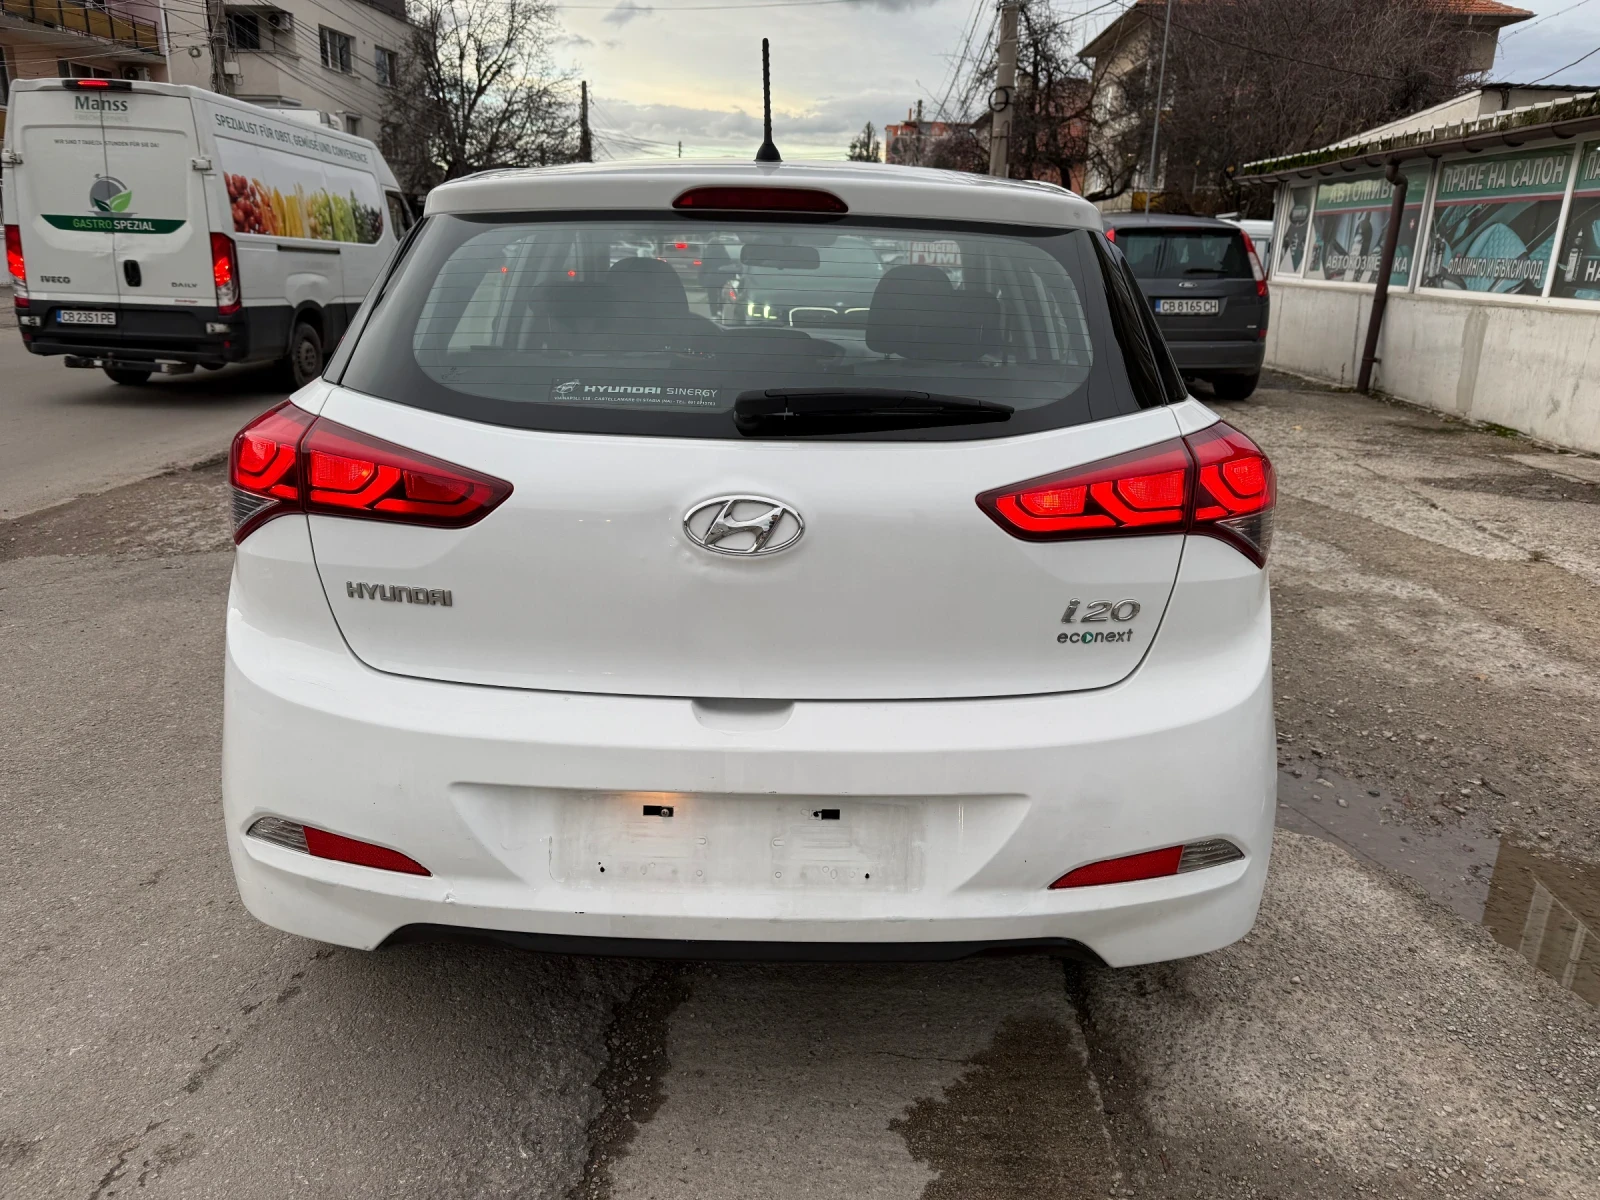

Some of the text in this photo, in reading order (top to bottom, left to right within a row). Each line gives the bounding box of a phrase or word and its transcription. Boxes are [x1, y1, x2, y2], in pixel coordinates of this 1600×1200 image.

[74, 95, 129, 112] Manss
[214, 113, 259, 136] SPEZIALIST
[259, 124, 275, 140] FÜR
[274, 129, 294, 146] OBST,
[293, 135, 319, 152] GEMÜSE
[1442, 155, 1567, 193] ПРАНЕ НА САЛОН
[1328, 179, 1407, 204] АВТОМИВ
[73, 218, 155, 231] GASTRO SPEZIAL
[1326, 254, 1408, 273] АВТОКОЗМЕКА
[1487, 259, 1494, 278] И
[1523, 260, 1544, 281] ООД
[40, 275, 71, 284] IVECO
[1177, 301, 1202, 312] 8165
[76, 311, 99, 323] 2351
[584, 385, 718, 398] HYUNDAI SINERGY
[346, 581, 453, 607] HYUNDAI
[1061, 598, 1141, 624] i20
